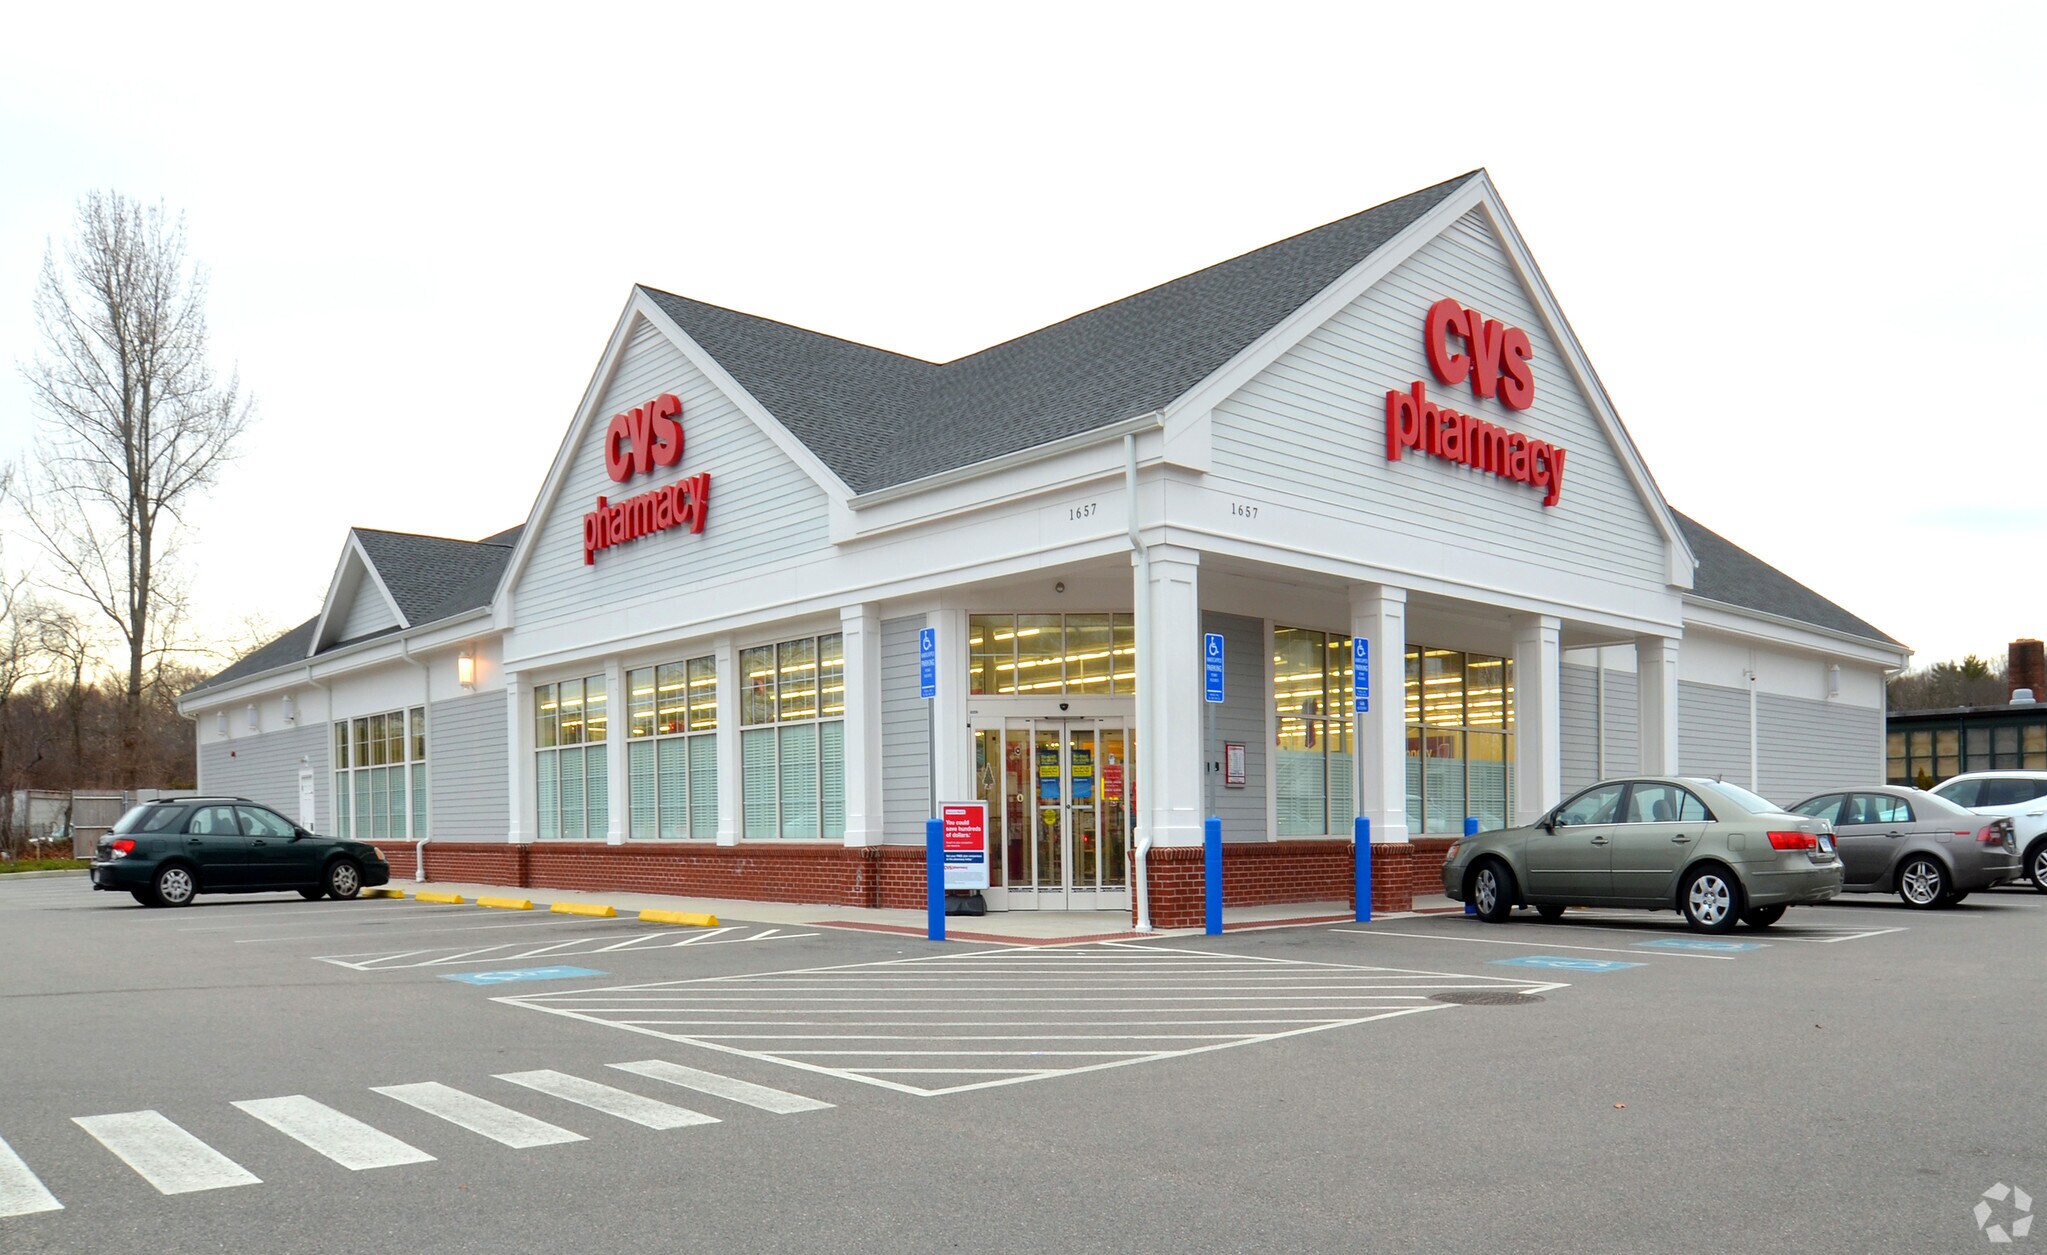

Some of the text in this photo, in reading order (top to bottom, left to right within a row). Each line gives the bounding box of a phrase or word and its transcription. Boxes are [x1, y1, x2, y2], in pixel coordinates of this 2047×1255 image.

[1425, 298, 1535, 411] CVS
[605, 393, 684, 483] CVS
[1386, 381, 1566, 507] pharmacy
[584, 472, 711, 566] pharmacy
[1069, 503, 1097, 520] 1657
[1231, 503, 1258, 519] 1657
